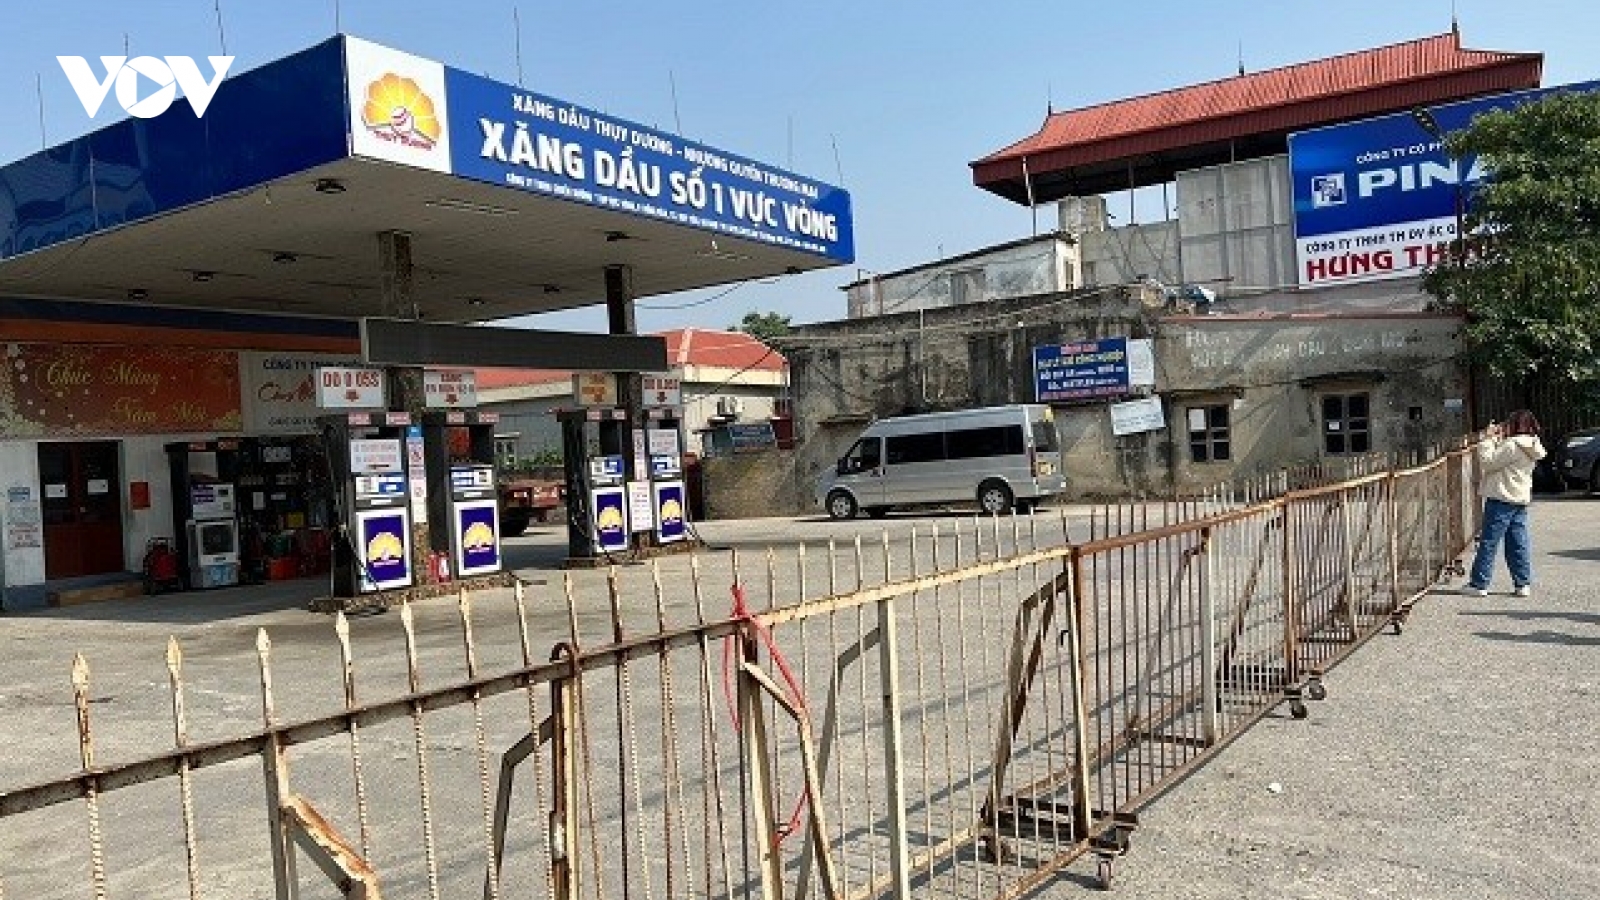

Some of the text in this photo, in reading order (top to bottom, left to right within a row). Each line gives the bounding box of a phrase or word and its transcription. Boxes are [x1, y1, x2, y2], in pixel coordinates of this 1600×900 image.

[1356, 150, 1390, 165] CÔNG
[1391, 147, 1405, 157] TY
[1358, 153, 1490, 197] PINA
[478, 116, 586, 180] XĂNG
[593, 144, 661, 197] DẦU
[668, 164, 706, 209] SỐ
[711, 182, 723, 215] 1
[728, 186, 778, 228] VỰC
[782, 199, 839, 242] VÒNG
[1306, 250, 1393, 283] HƯNG
